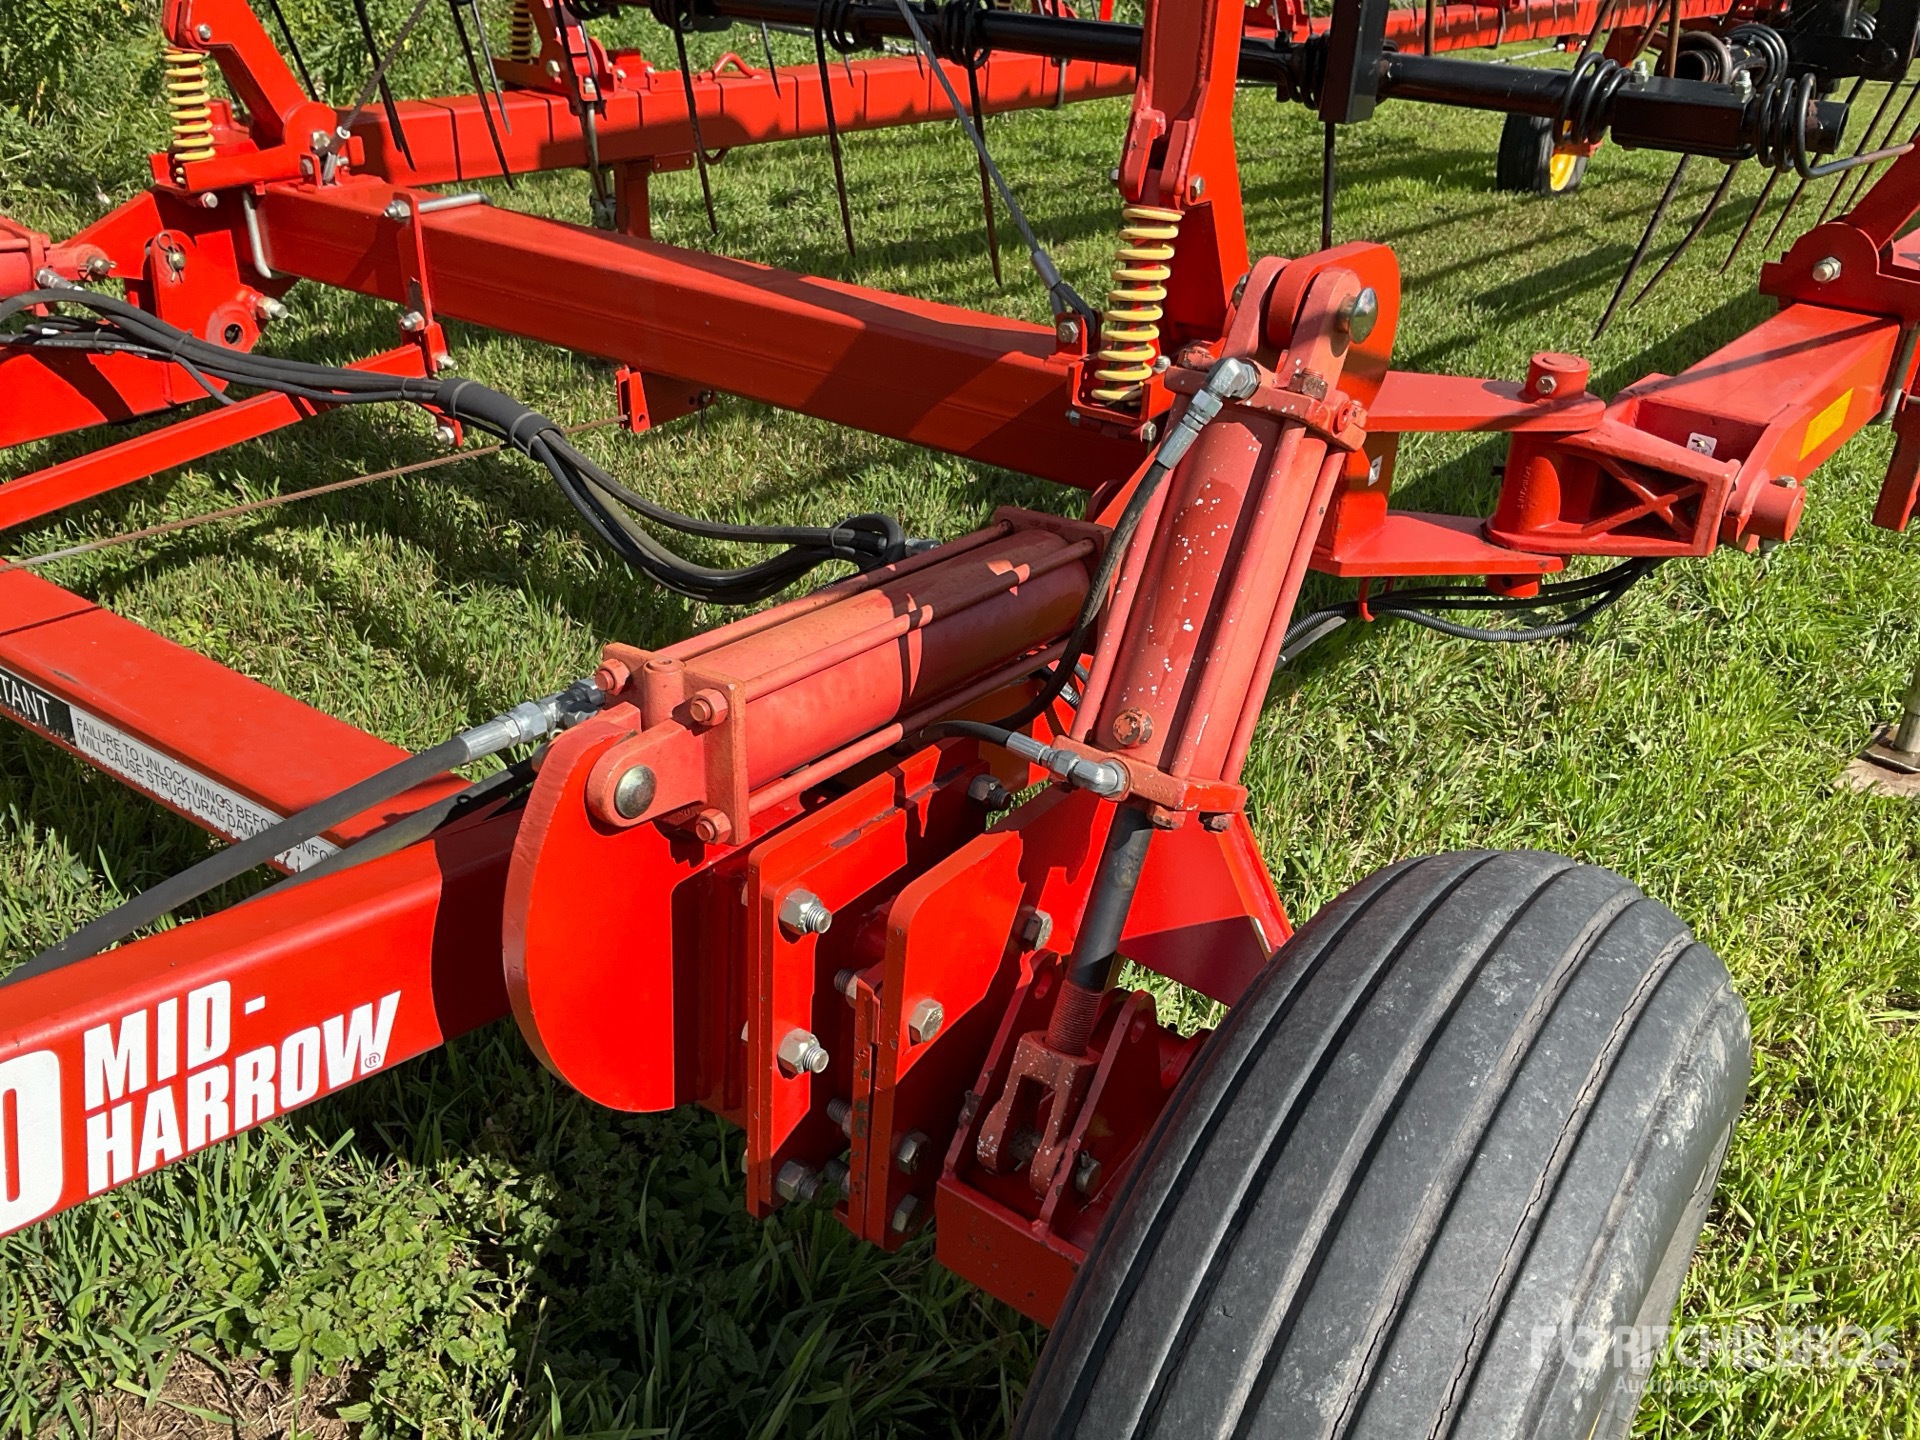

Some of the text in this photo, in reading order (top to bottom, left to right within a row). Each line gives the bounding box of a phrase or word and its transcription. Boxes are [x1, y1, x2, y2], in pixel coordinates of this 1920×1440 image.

[0, 673, 49, 725] TANT
[76, 717, 121, 752] FAILURE
[122, 742, 139, 761] TO
[141, 752, 189, 789] UNLOCK
[191, 779, 233, 813] WINGS
[295, 842, 333, 862] NFO
[79, 732, 105, 757] WILL
[106, 747, 144, 778] CAUSE
[146, 769, 225, 823] STRUCTURAL
